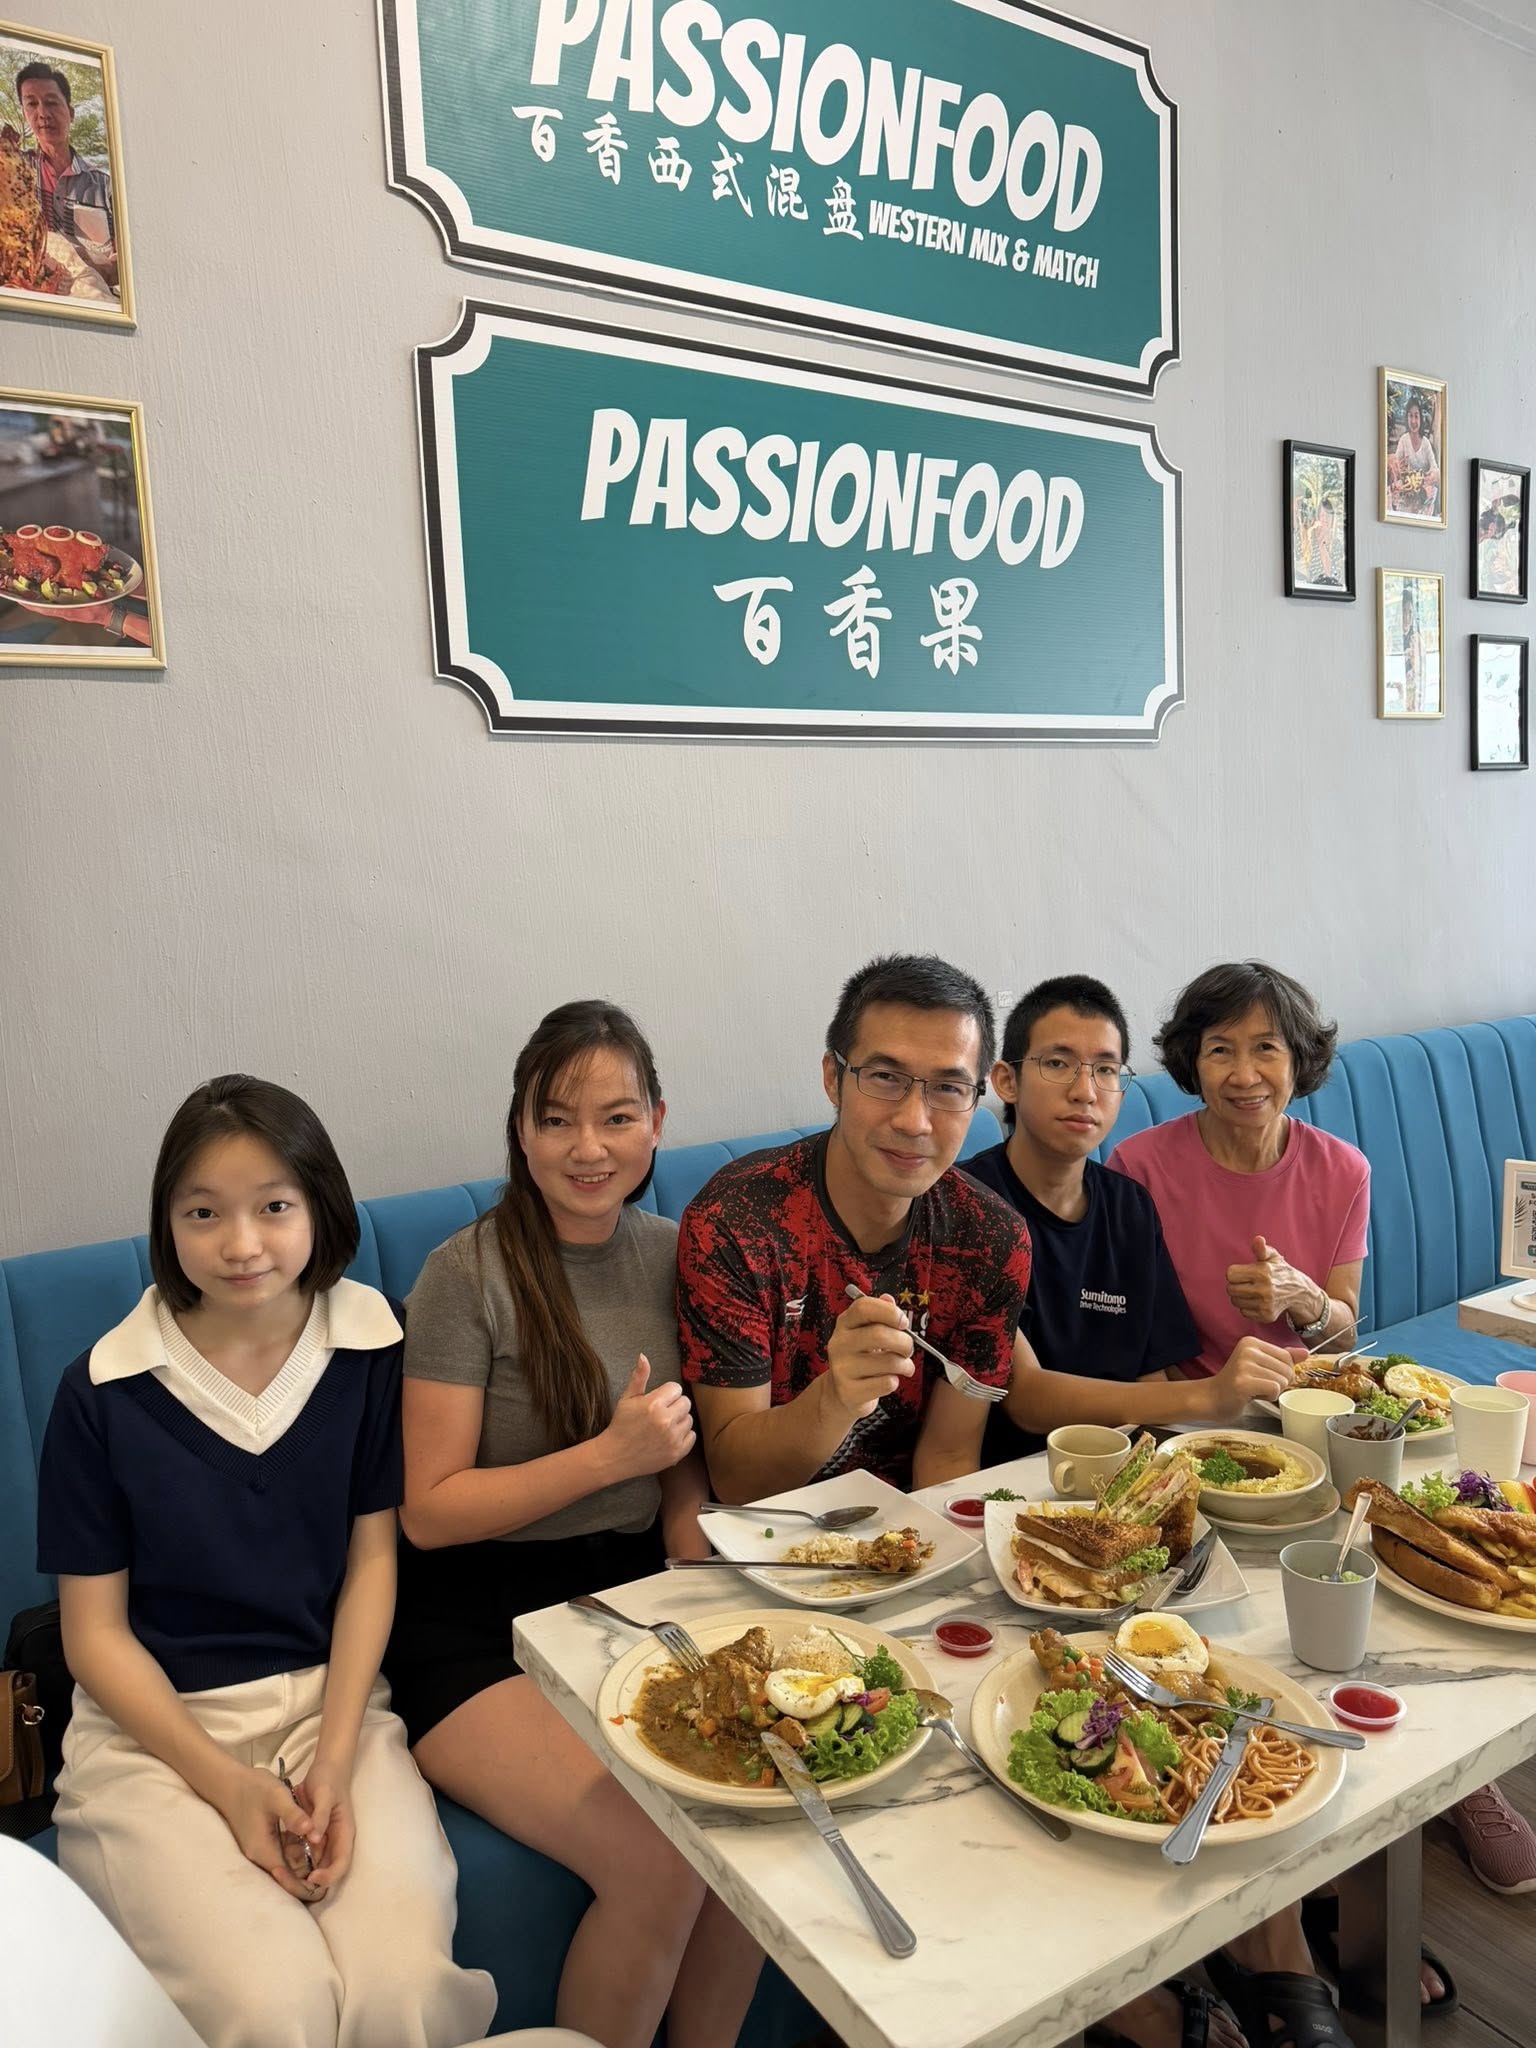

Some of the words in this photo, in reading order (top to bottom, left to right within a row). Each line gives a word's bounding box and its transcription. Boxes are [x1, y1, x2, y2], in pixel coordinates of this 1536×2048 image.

[511, 105, 864, 241] 百香西式混盘
[530, 0, 1103, 233] PASSIONFOOD
[868, 200, 967, 255] WESTERN
[968, 227, 1010, 267] MIX
[1012, 238, 1031, 272] &
[1032, 244, 1100, 288] MATCH
[580, 407, 1085, 570] PASSIONFOOD
[712, 564, 984, 680] 百香果
[1080, 1288, 1127, 1305] Sumitomo
[1092, 1302, 1127, 1315] Technologies
